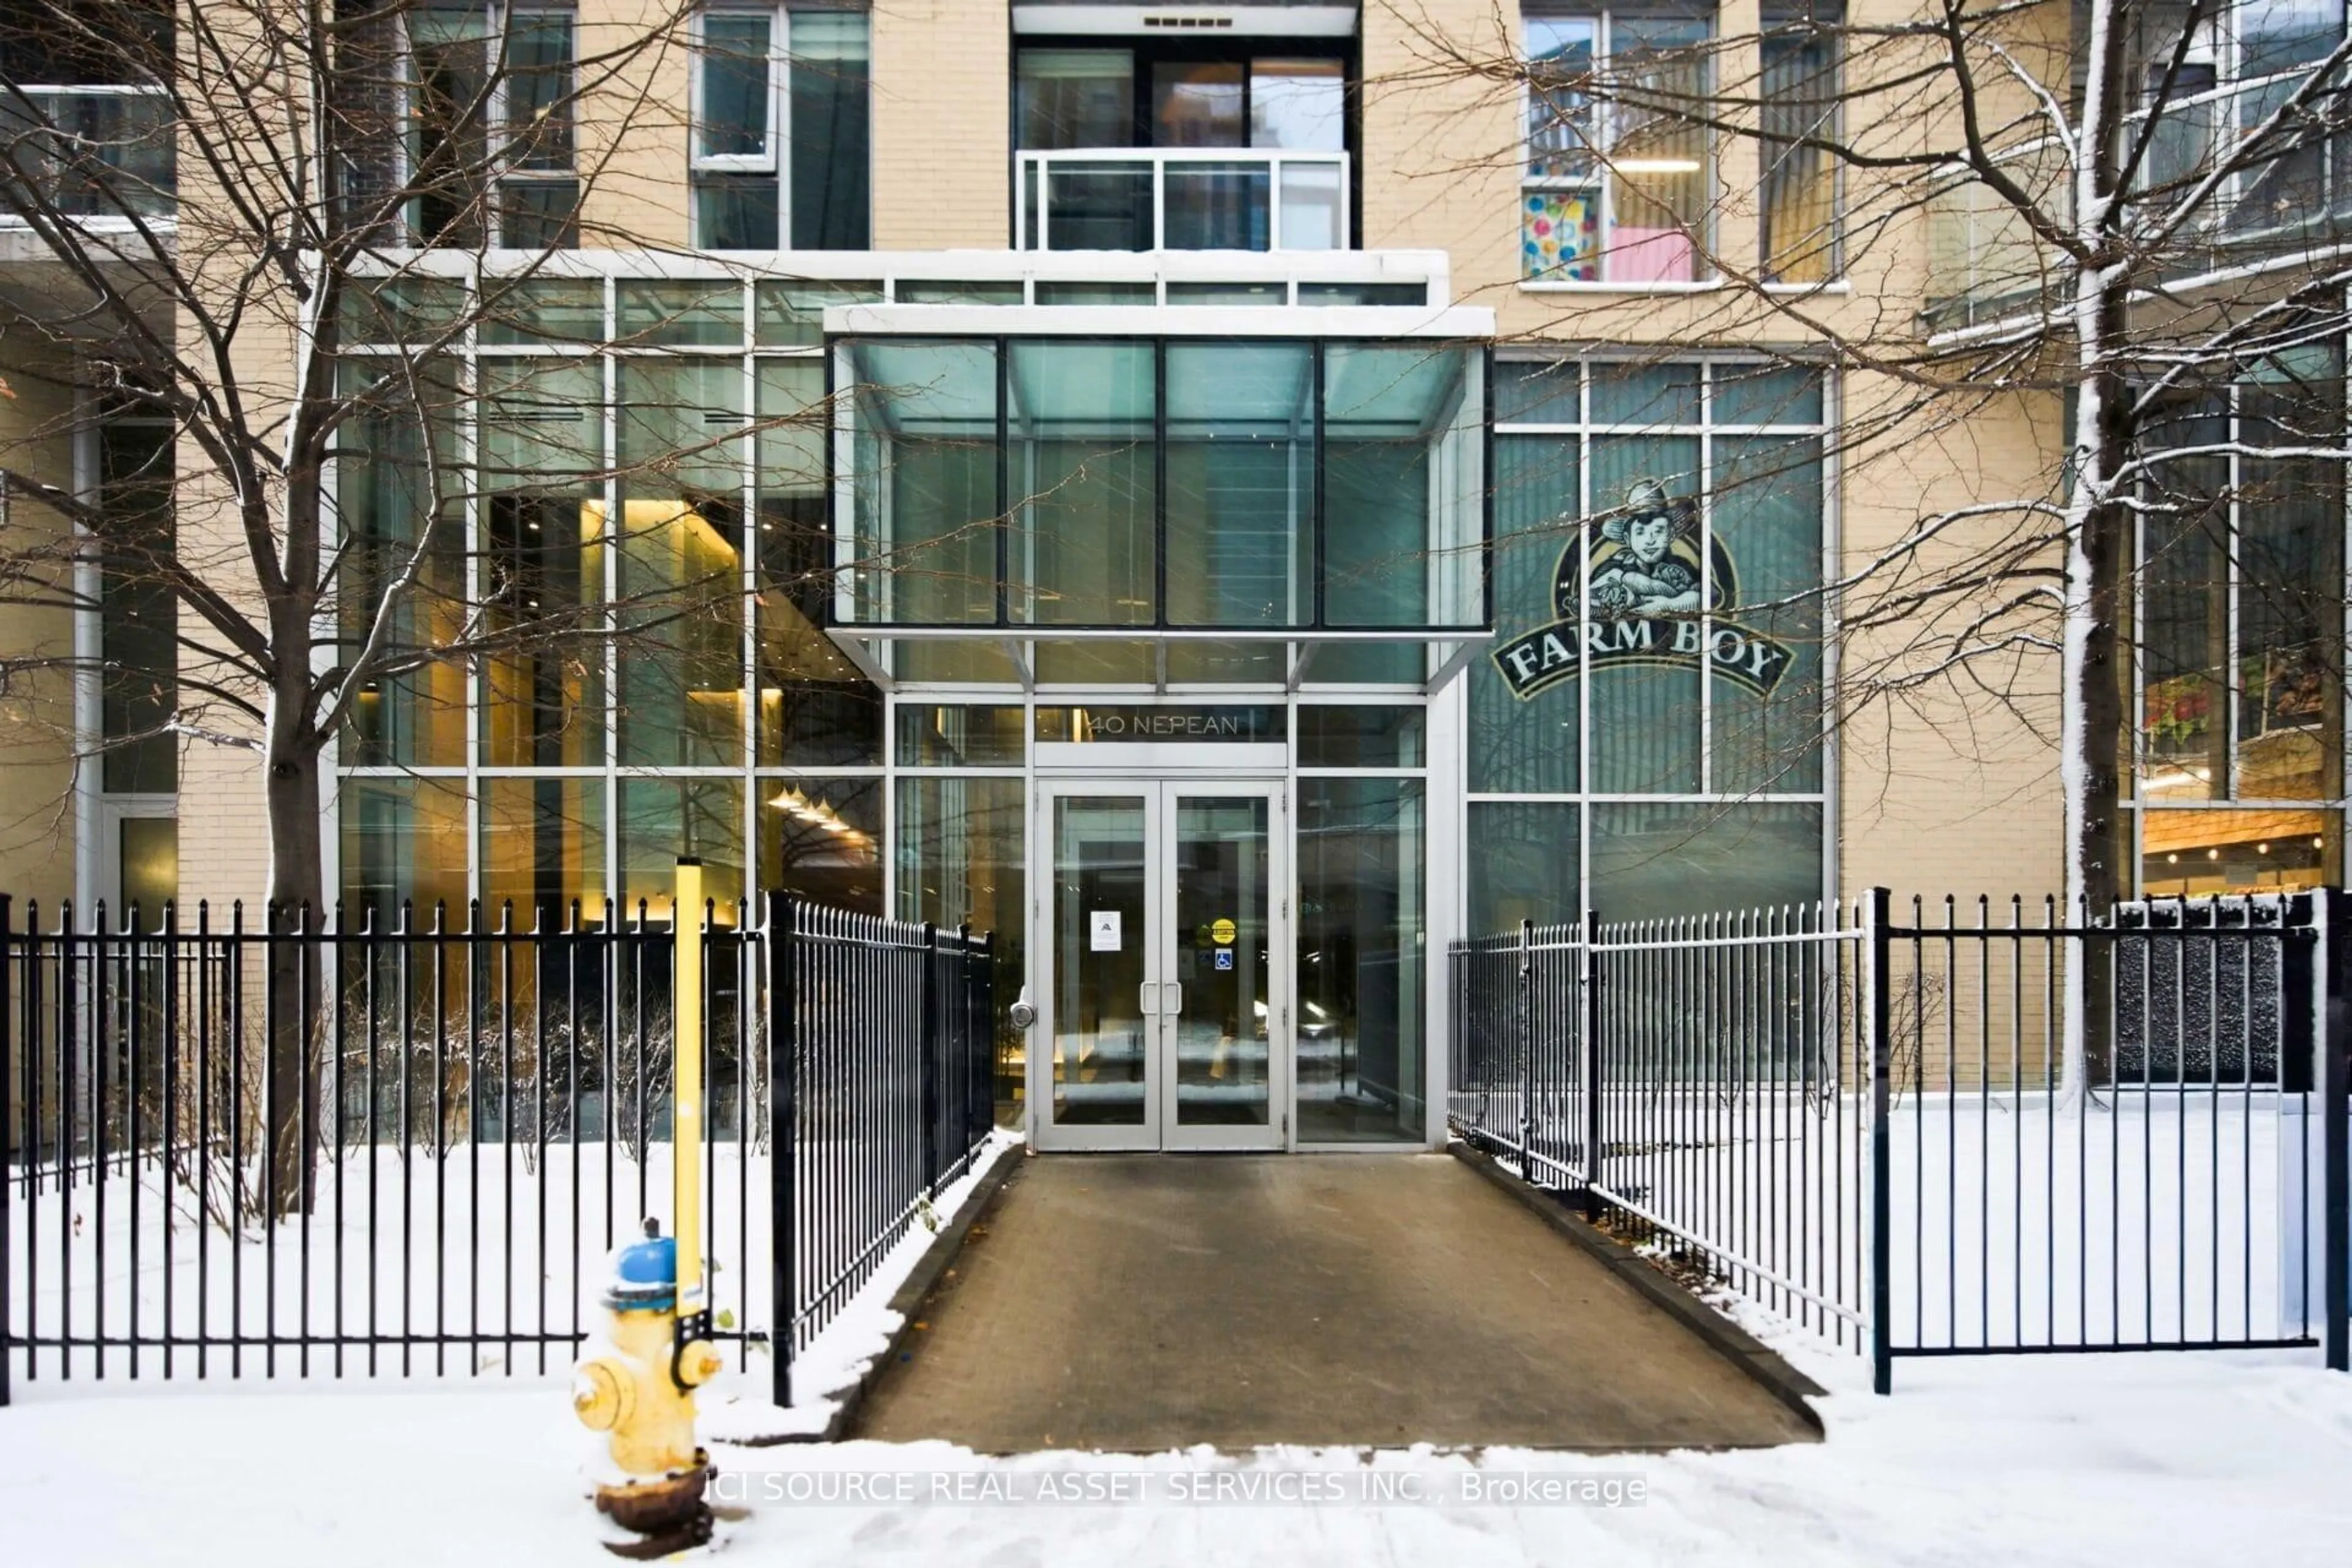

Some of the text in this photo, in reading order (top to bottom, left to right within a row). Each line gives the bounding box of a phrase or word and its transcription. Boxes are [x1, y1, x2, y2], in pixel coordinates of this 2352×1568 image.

[1506, 619, 1784, 684] FARM BOY
[1089, 715, 1237, 734] 40 NEPEAN
